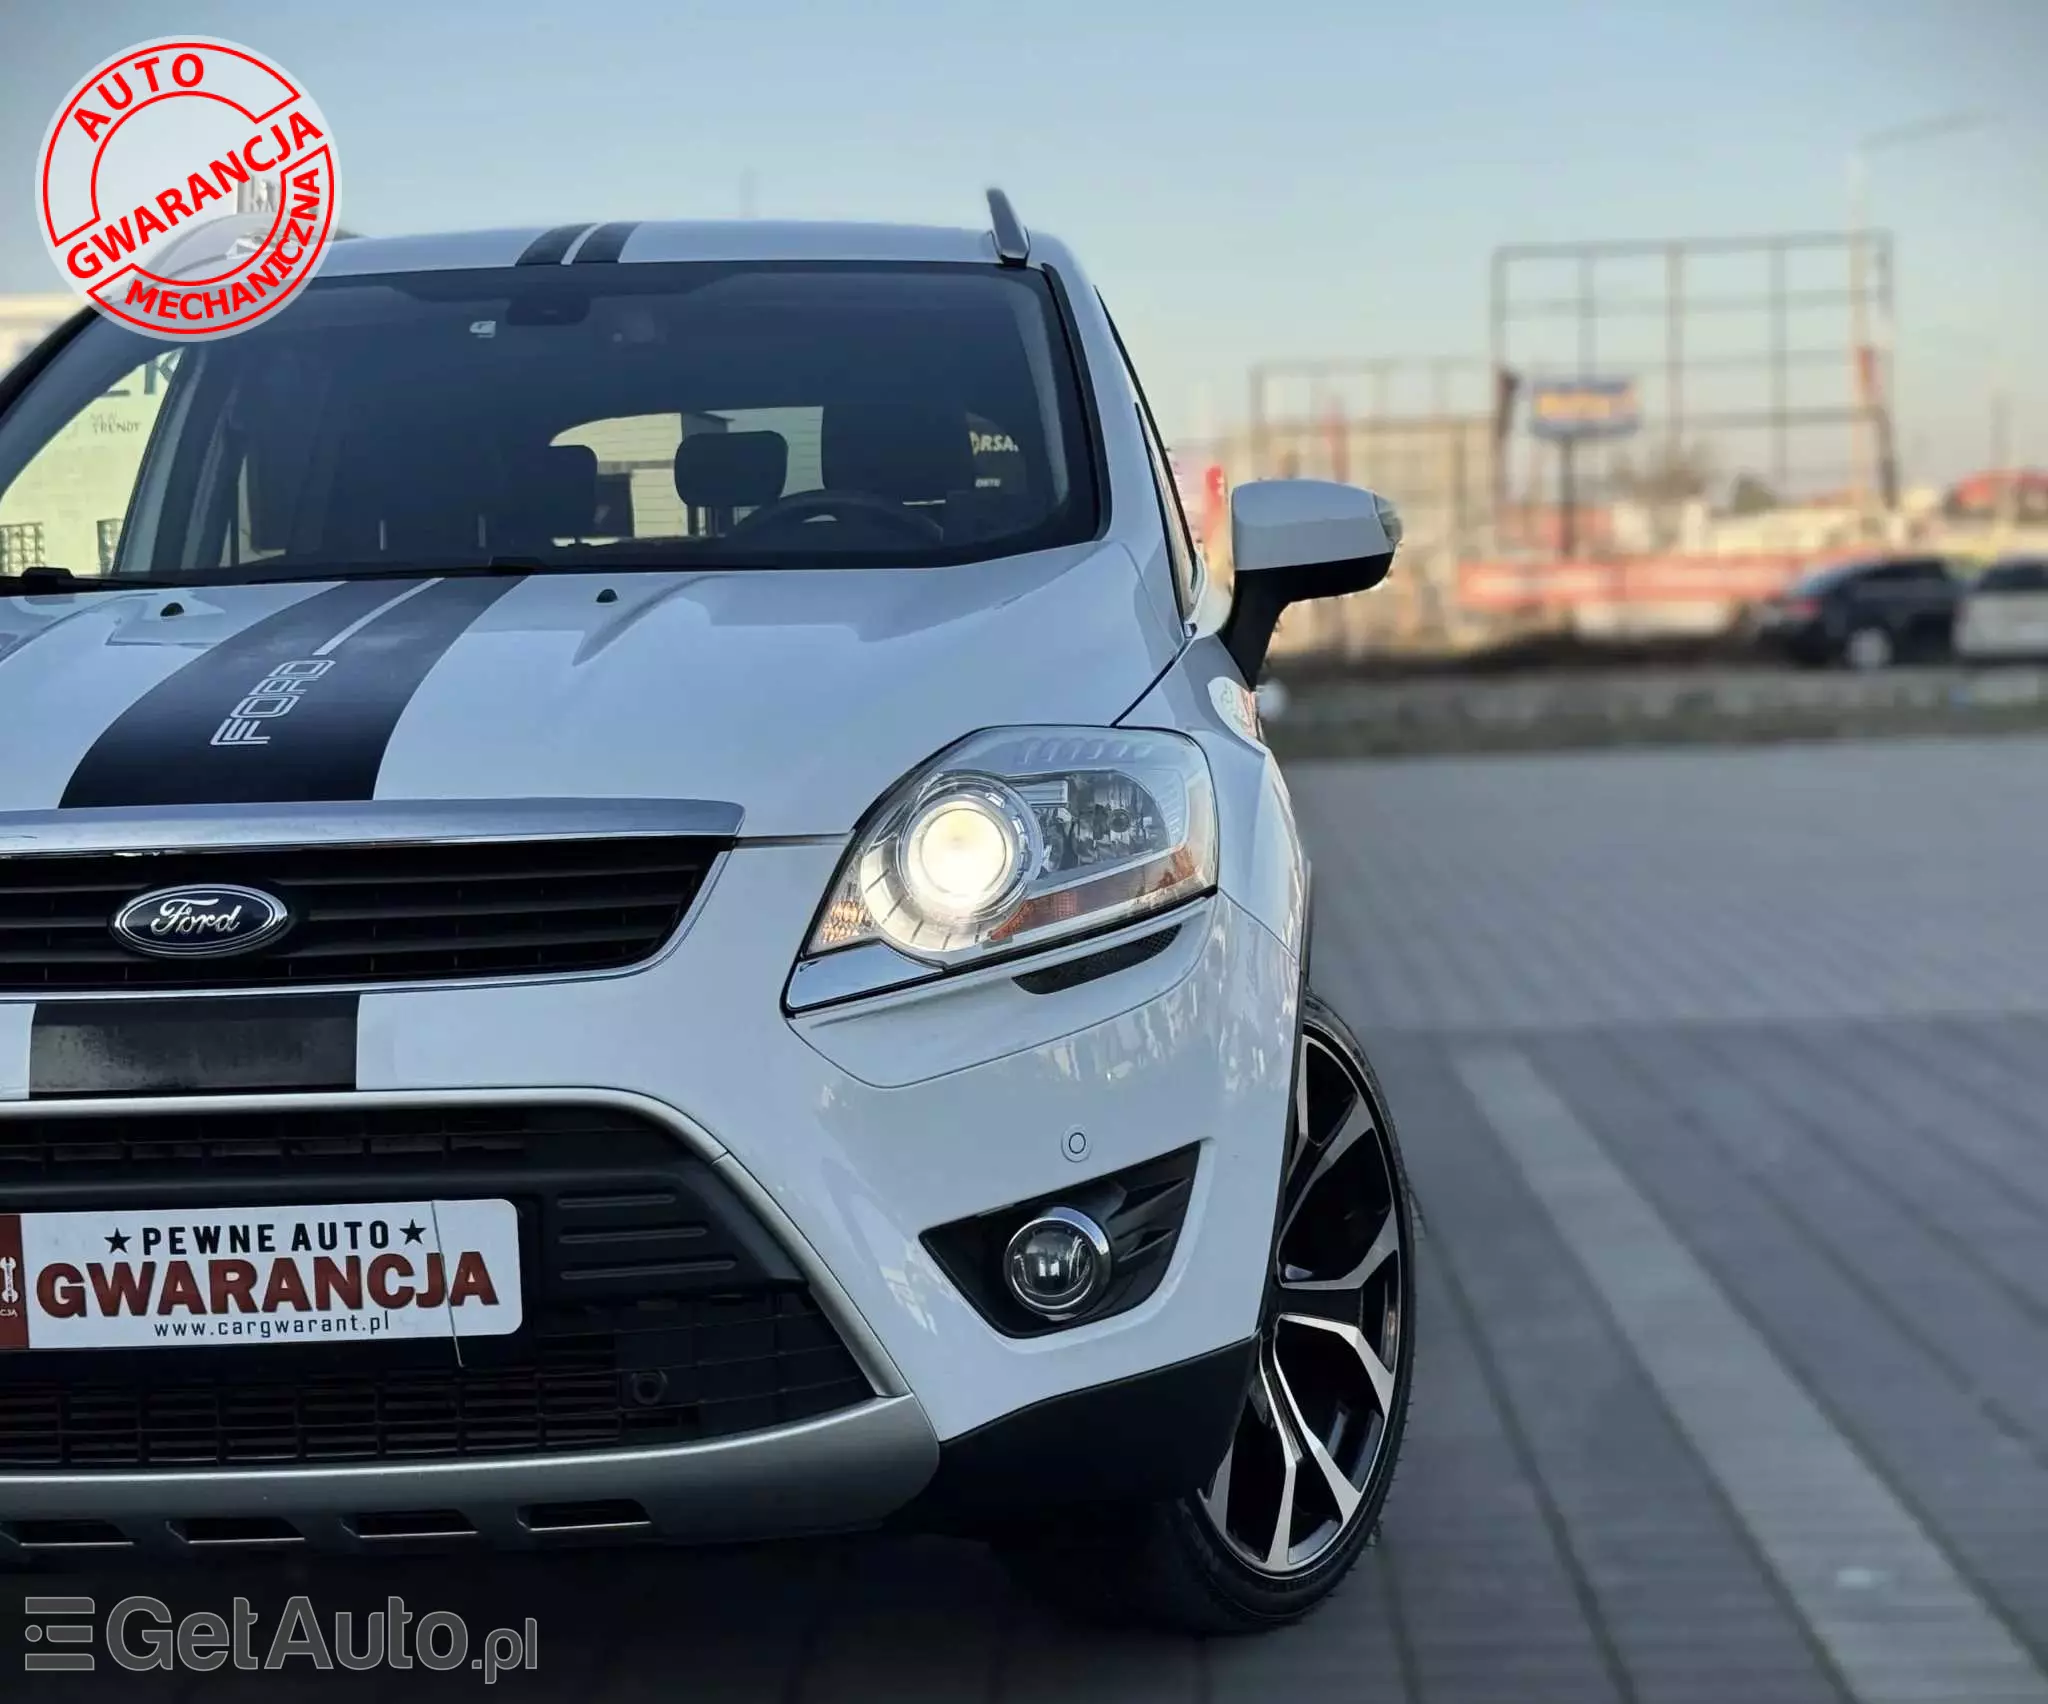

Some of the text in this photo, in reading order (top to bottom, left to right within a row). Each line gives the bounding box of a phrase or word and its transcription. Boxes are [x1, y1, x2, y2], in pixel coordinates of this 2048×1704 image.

[210, 659, 337, 746] FORD
[151, 898, 242, 936] Ford
[143, 1220, 390, 1255] PEWNE AUTO
[36, 1251, 500, 1318] GWARANCJA
[154, 1310, 390, 1338] www.cargwarant.pl
